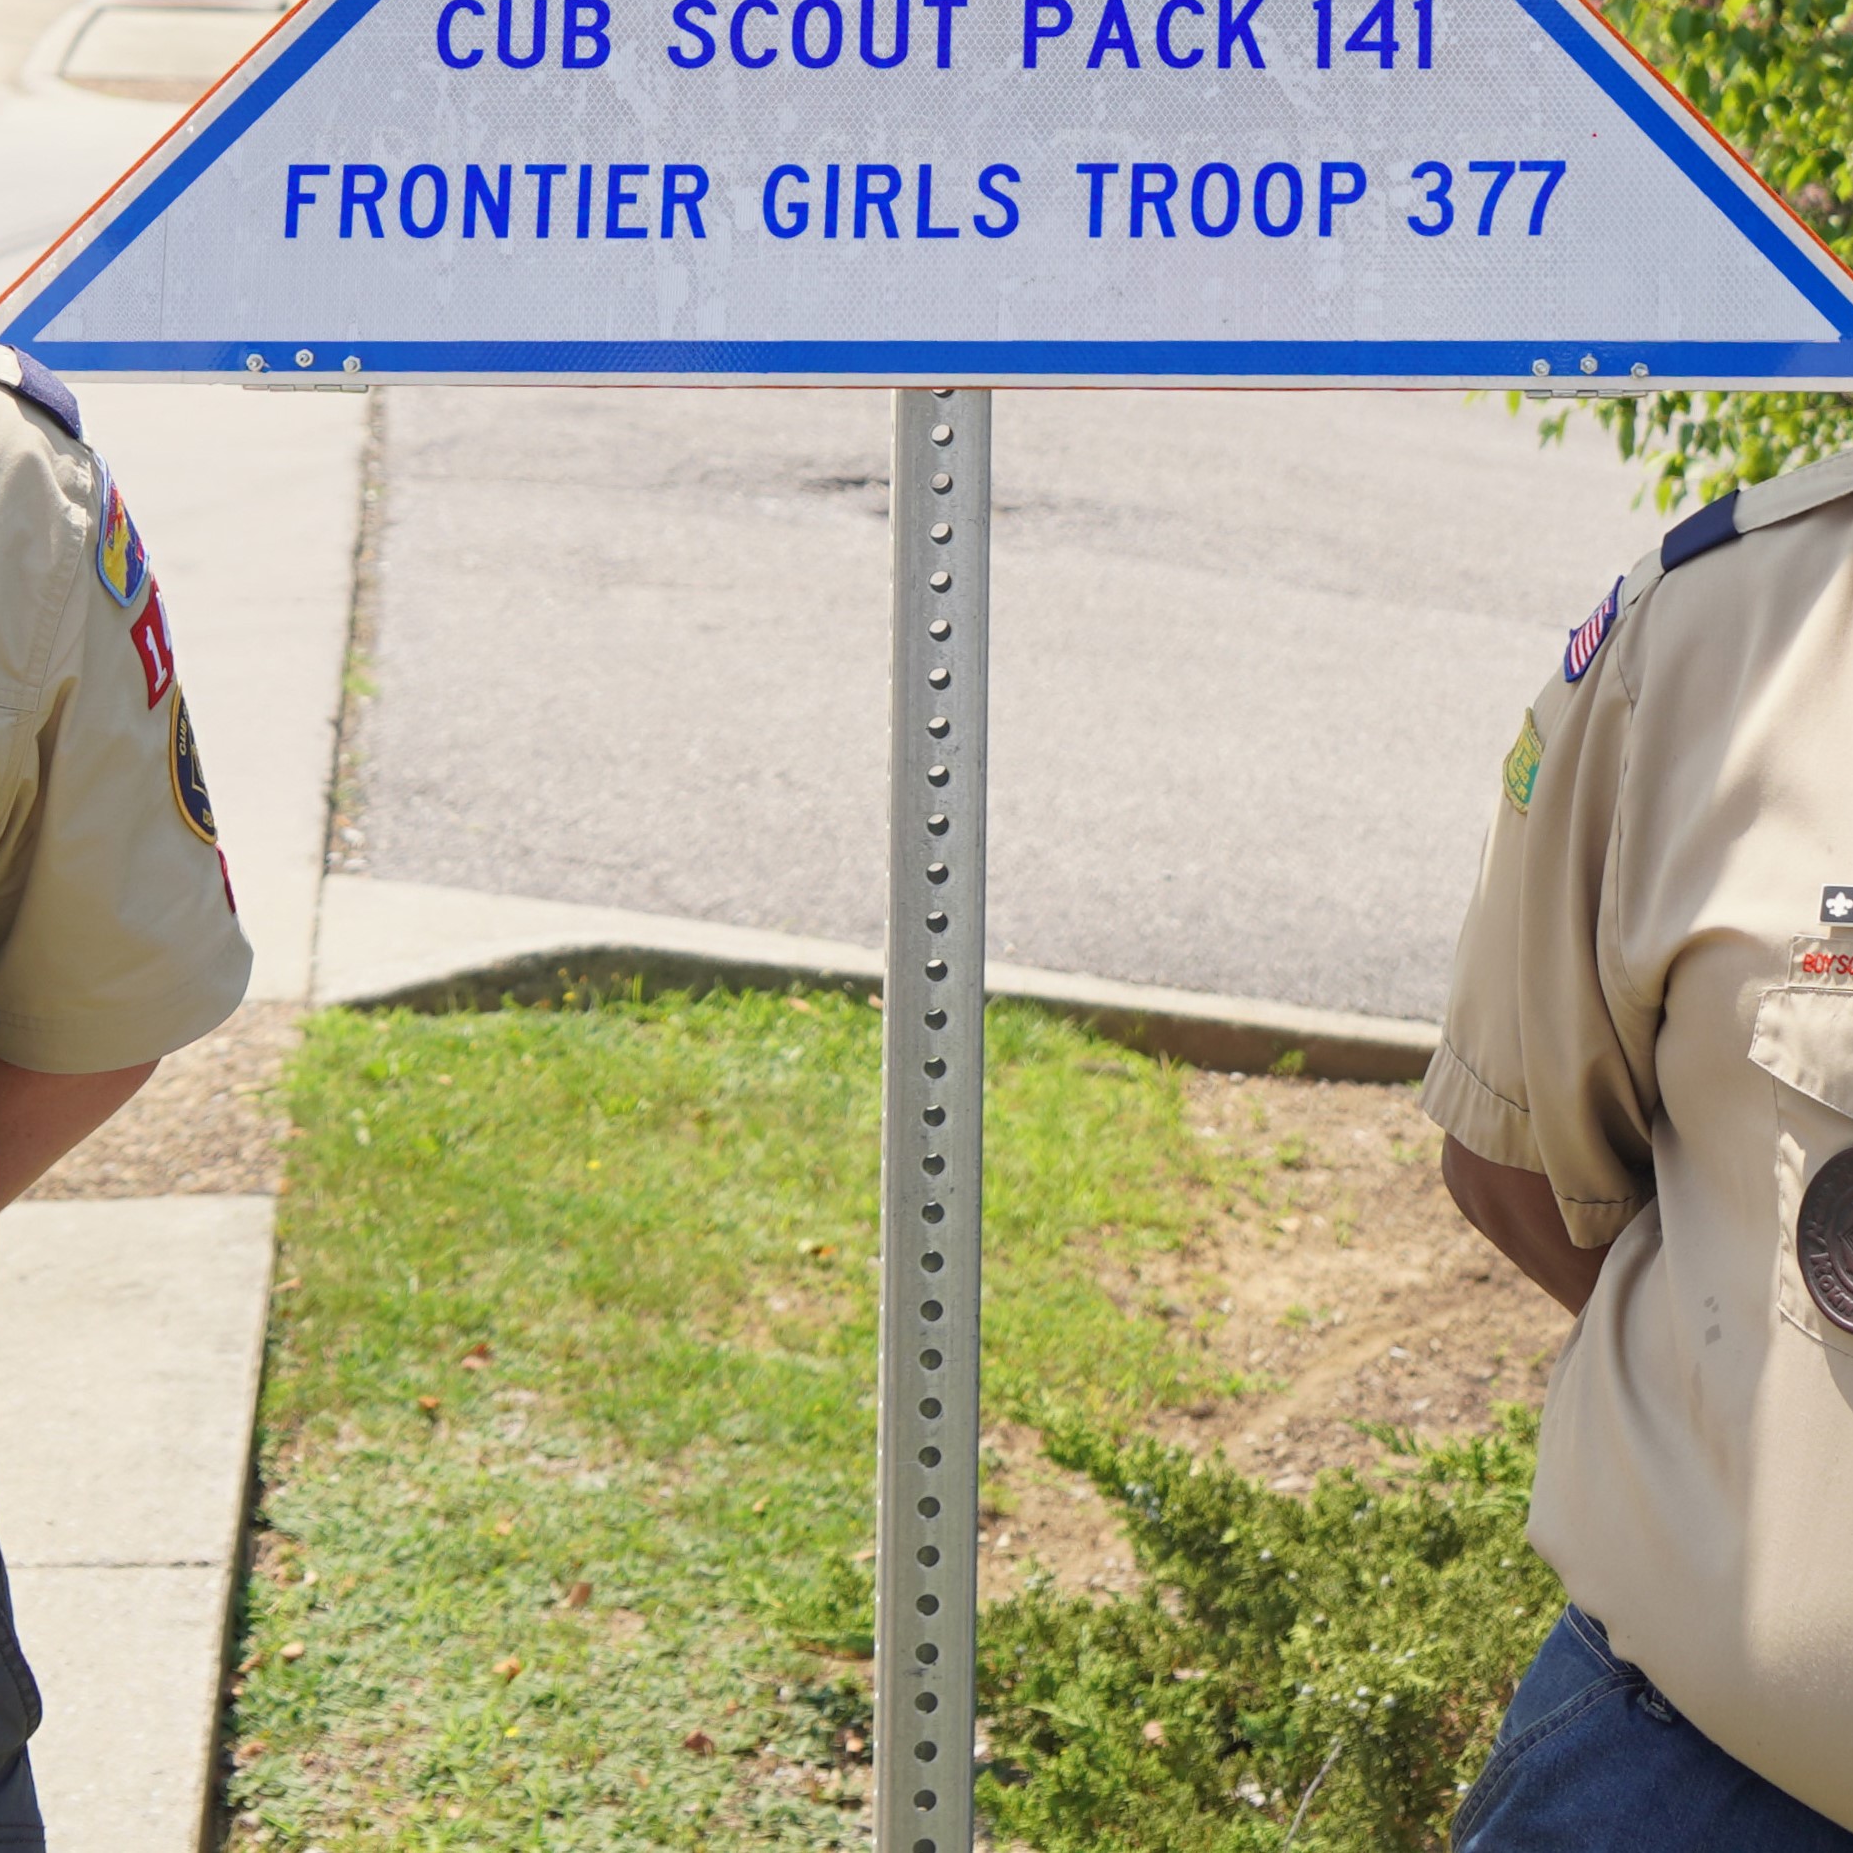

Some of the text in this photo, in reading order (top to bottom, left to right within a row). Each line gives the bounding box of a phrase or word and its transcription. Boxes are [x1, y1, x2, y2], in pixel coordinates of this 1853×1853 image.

[284, 159, 1567, 240] FRONTIER GIRLS TROOP 377
[1802, 952, 1833, 974] BOY
